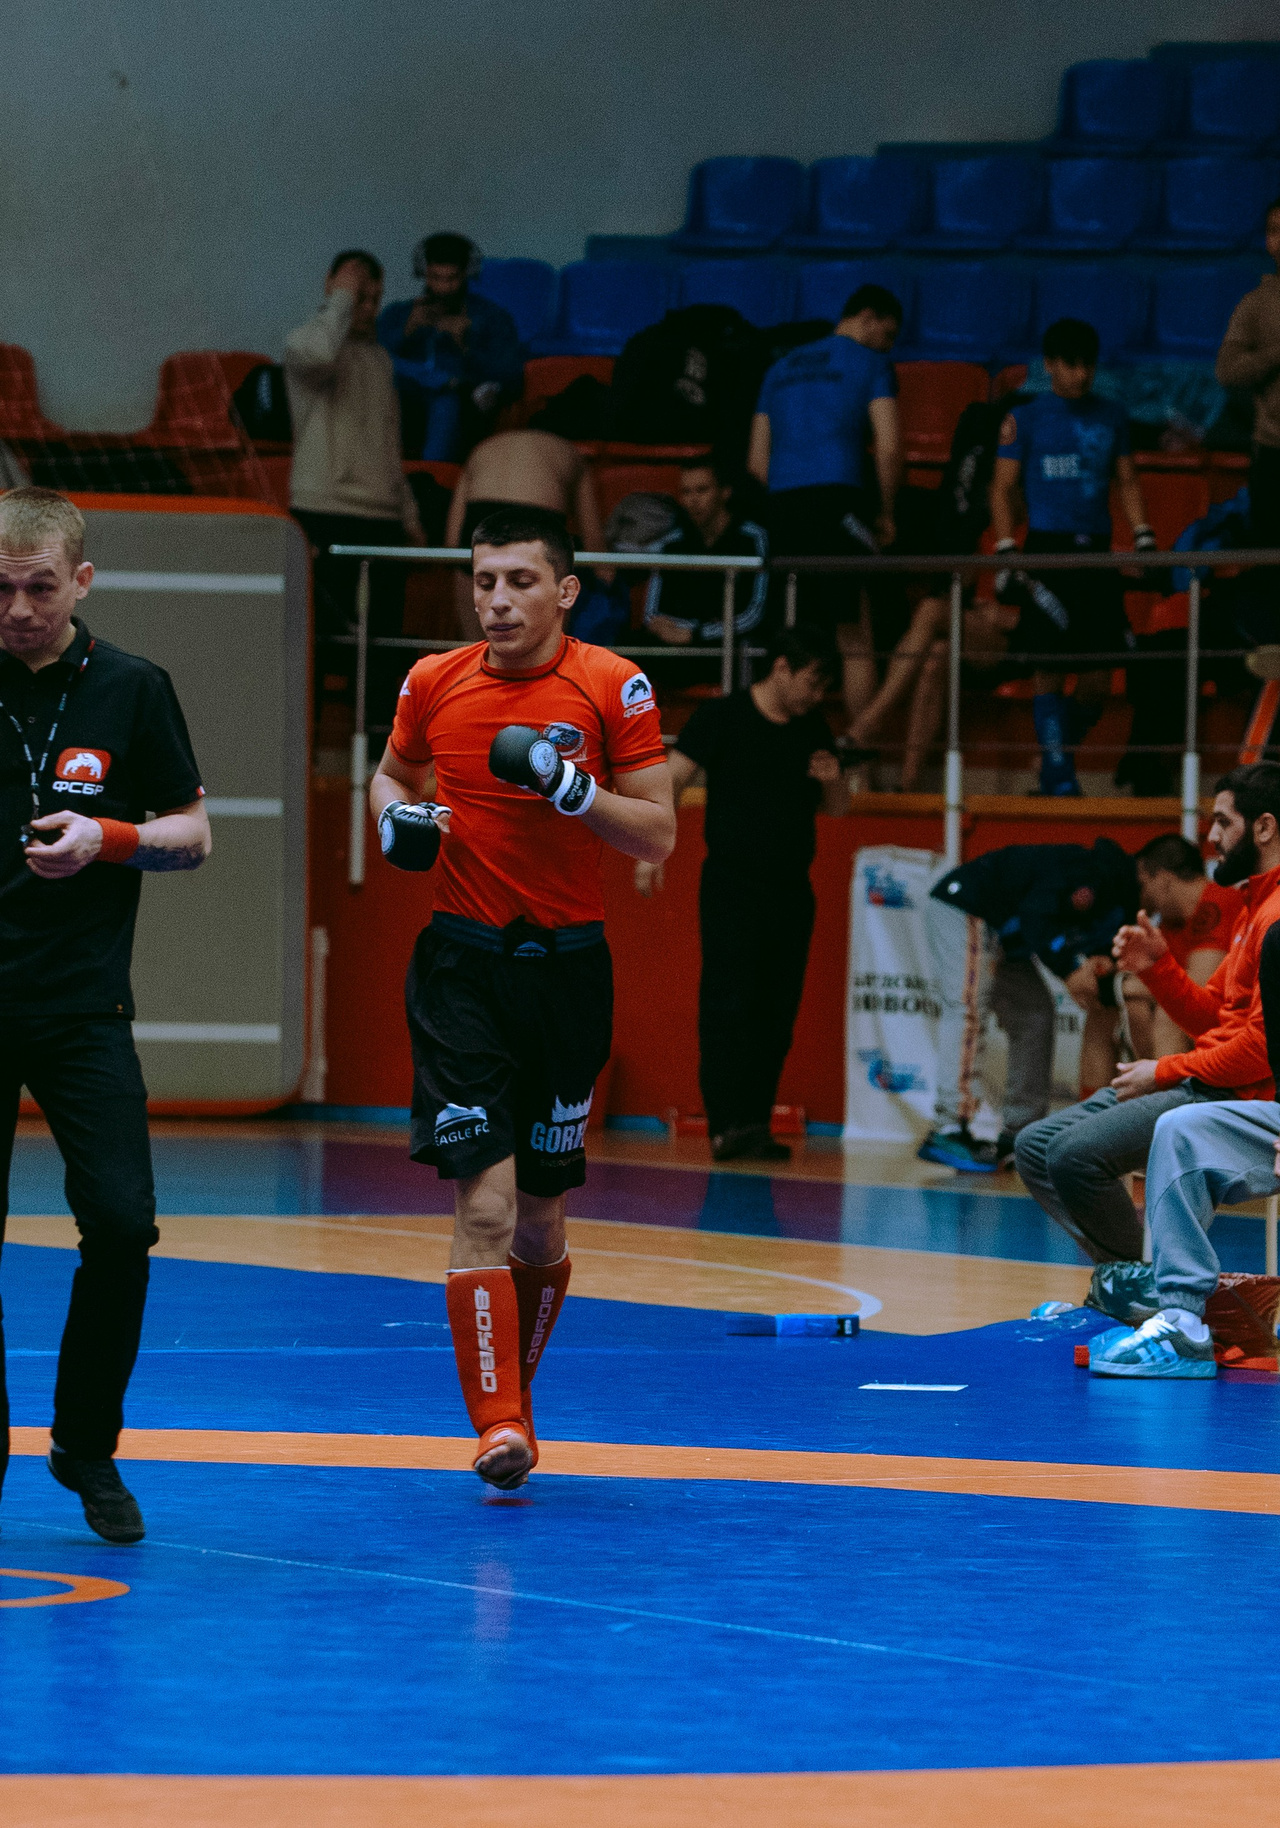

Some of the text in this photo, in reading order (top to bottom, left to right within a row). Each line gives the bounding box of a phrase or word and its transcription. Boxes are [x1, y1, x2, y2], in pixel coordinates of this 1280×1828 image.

[52, 781, 104, 795] ФСБР
[474, 1122, 490, 1136] FC
[474, 1286, 497, 1393] BOYBO
